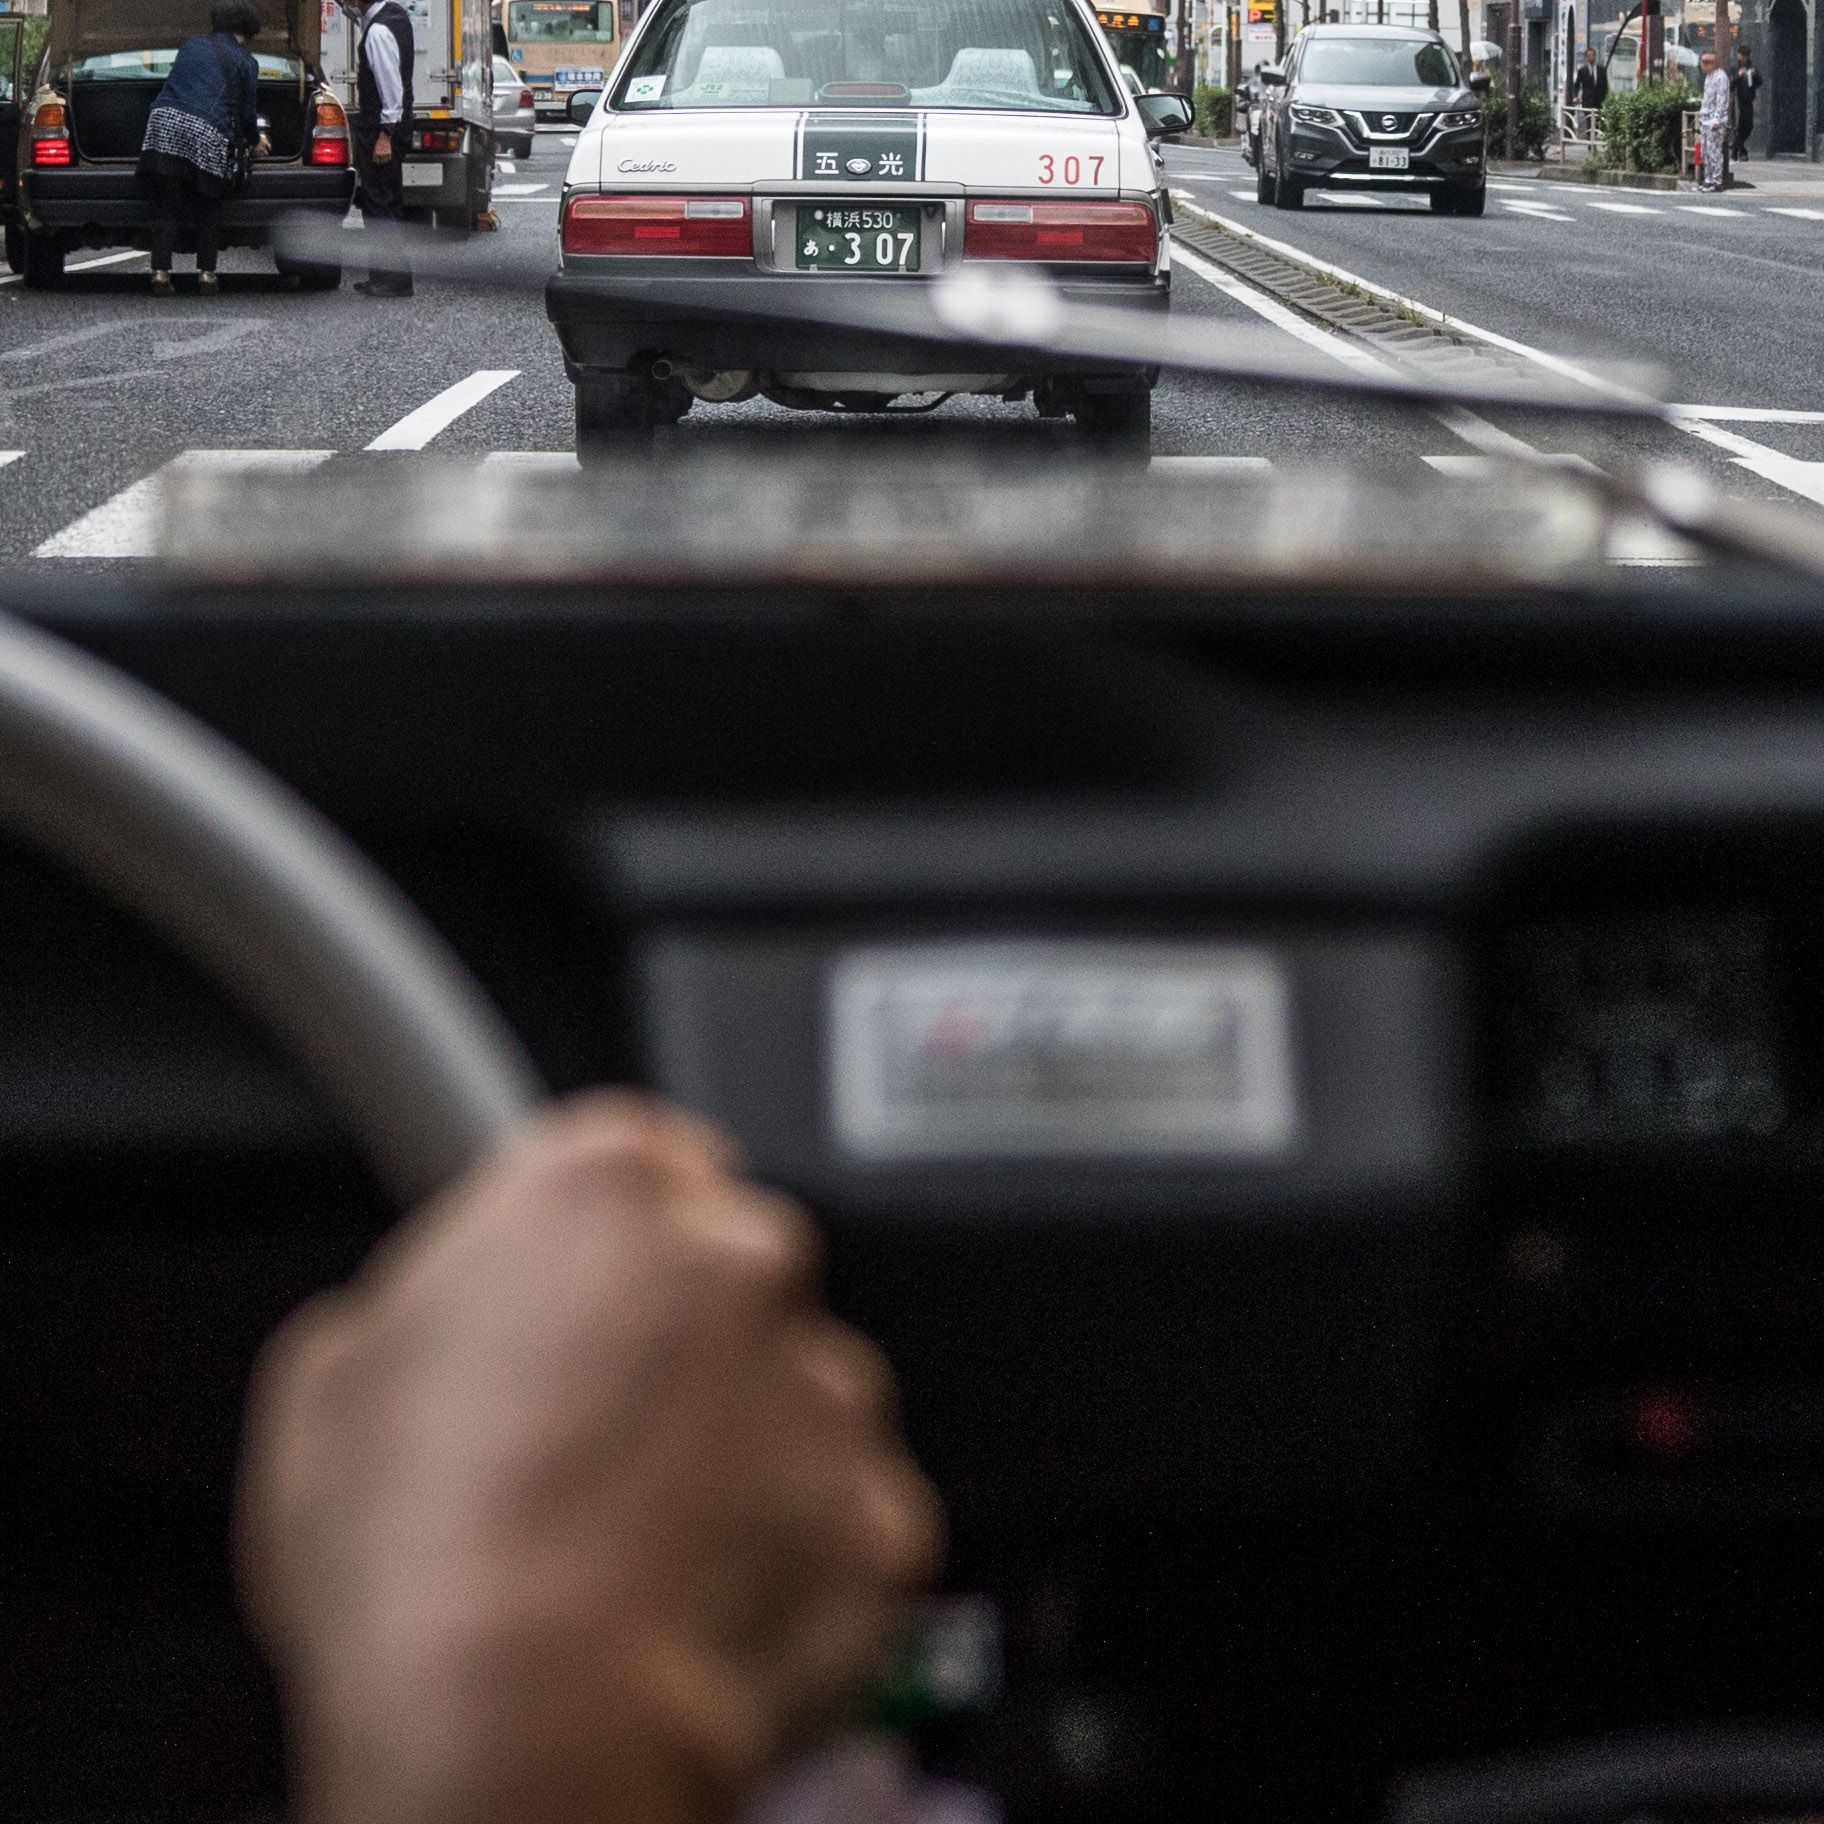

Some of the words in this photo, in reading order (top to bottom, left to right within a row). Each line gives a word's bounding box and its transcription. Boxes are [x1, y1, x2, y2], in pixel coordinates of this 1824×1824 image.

[617, 158, 677, 173] Cedric
[1038, 154, 1105, 186] 307
[1378, 156, 1407, 168] 81-33
[825, 210, 894, 229] 横浜530
[803, 240, 819, 257] あ
